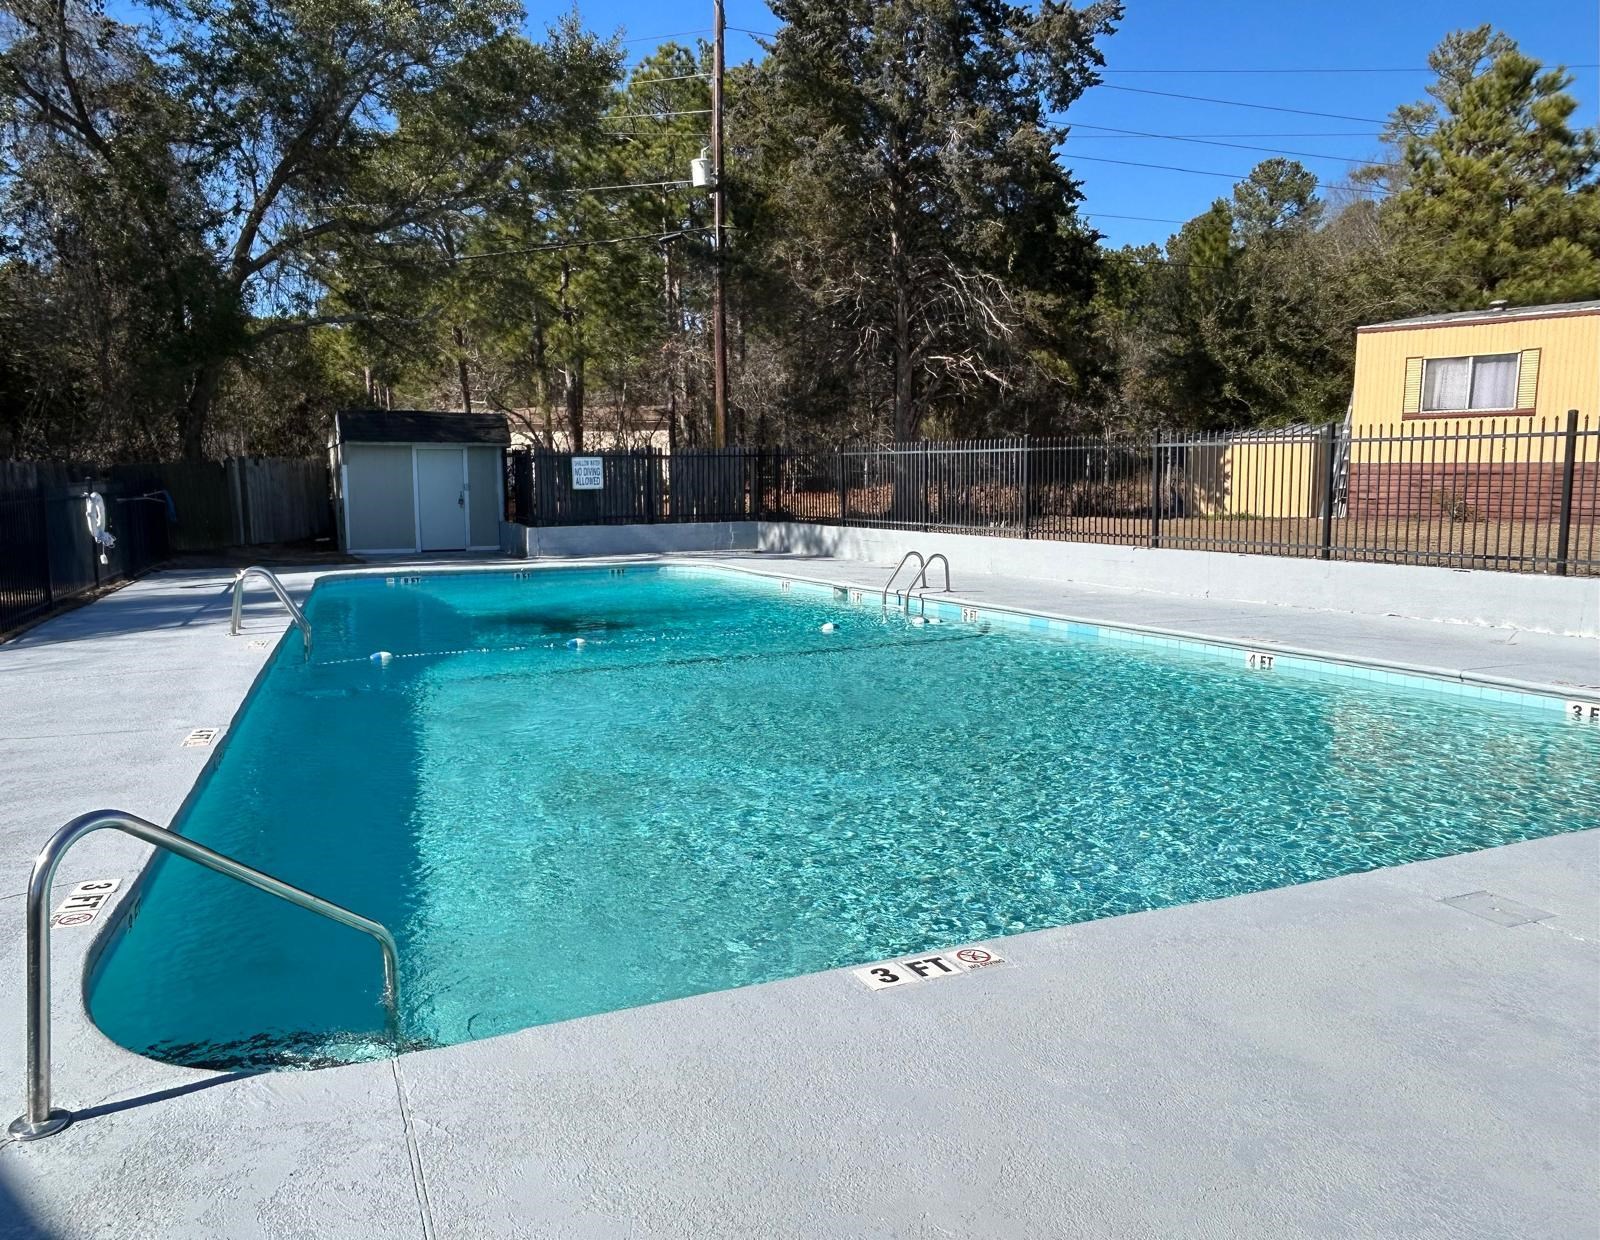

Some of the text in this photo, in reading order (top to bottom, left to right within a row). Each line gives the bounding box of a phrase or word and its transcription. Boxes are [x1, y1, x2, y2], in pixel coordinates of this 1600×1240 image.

[575, 467, 600, 476] NO DIVING
[576, 477, 600, 486] ALLOWED
[1589, 706, 1600, 720] F
[65, 882, 113, 909] 3 FT
[980, 958, 1006, 969] DIVING
[870, 957, 953, 983] 3 FT
